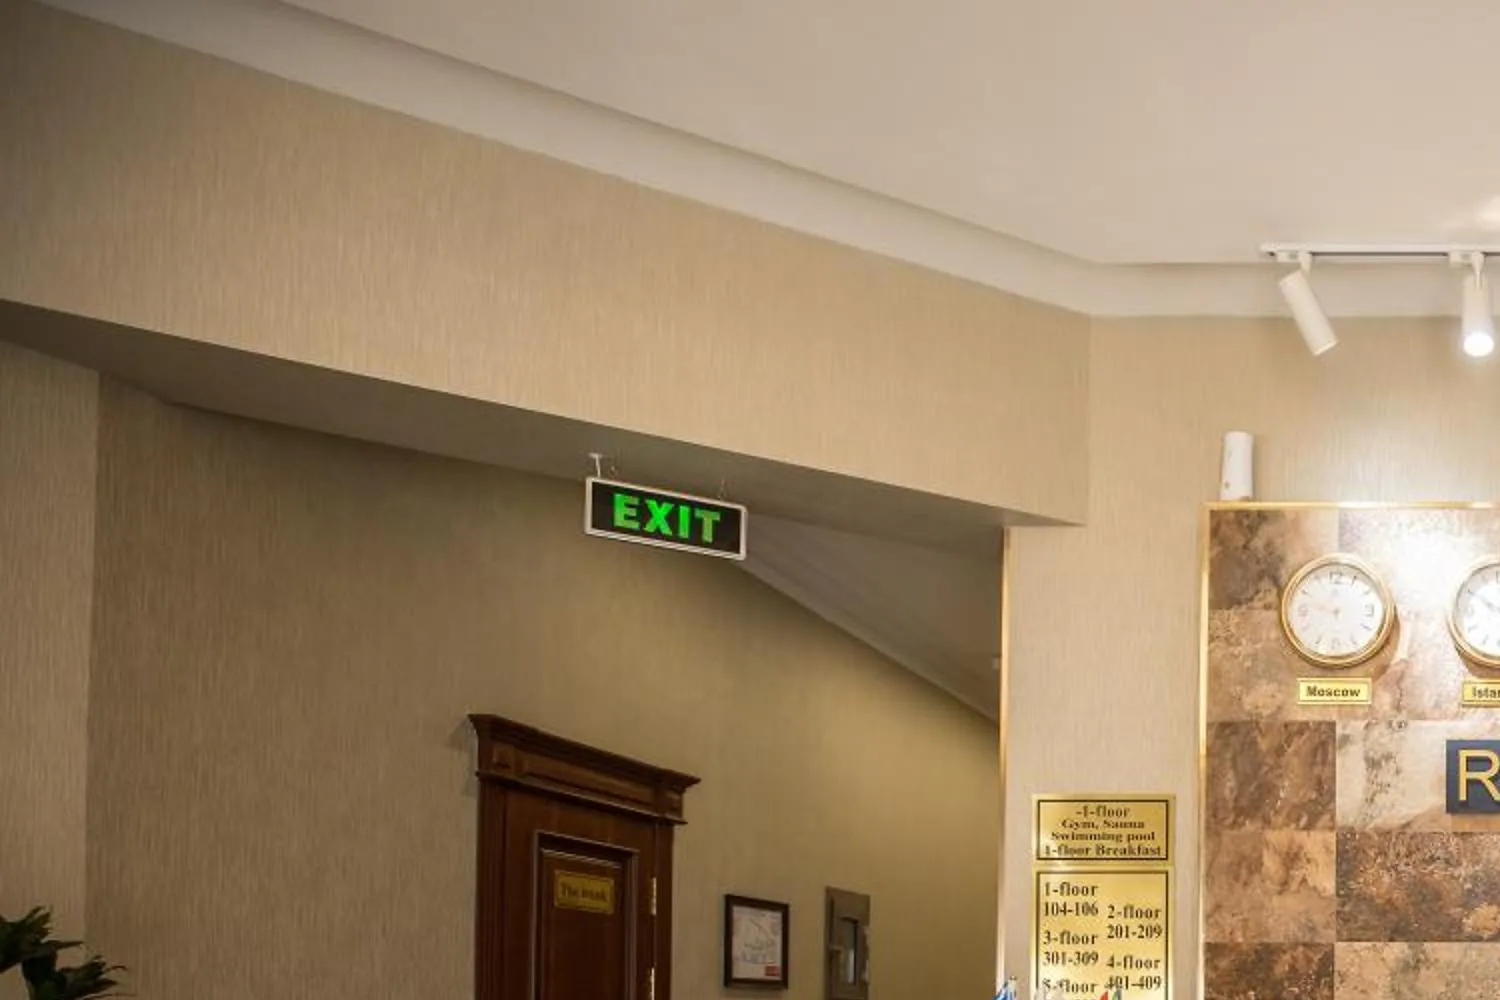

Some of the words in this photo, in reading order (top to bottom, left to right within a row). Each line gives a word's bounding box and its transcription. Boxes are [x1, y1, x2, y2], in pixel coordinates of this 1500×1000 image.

[613, 493, 721, 543] EXIT
[1306, 686, 1361, 697] Moscow
[1061, 819, 1099, 830] Gym,
[1103, 819, 1145, 829] Sauna
[1051, 831, 1124, 843] Swimming
[1127, 831, 1155, 843] pool
[1045, 844, 1092, 856] 1-floor
[1095, 844, 1161, 856] Breakfast
[1045, 882, 1098, 896] 1-floor
[1044, 901, 1098, 917] 104-106
[1107, 904, 1162, 919] 2-floor
[1043, 930, 1098, 945] 3-floor
[1107, 924, 1162, 939] 201-209
[1043, 951, 1098, 966] 301-309
[1106, 954, 1161, 969] 4-floor
[1104, 975, 1162, 990] 401-409
